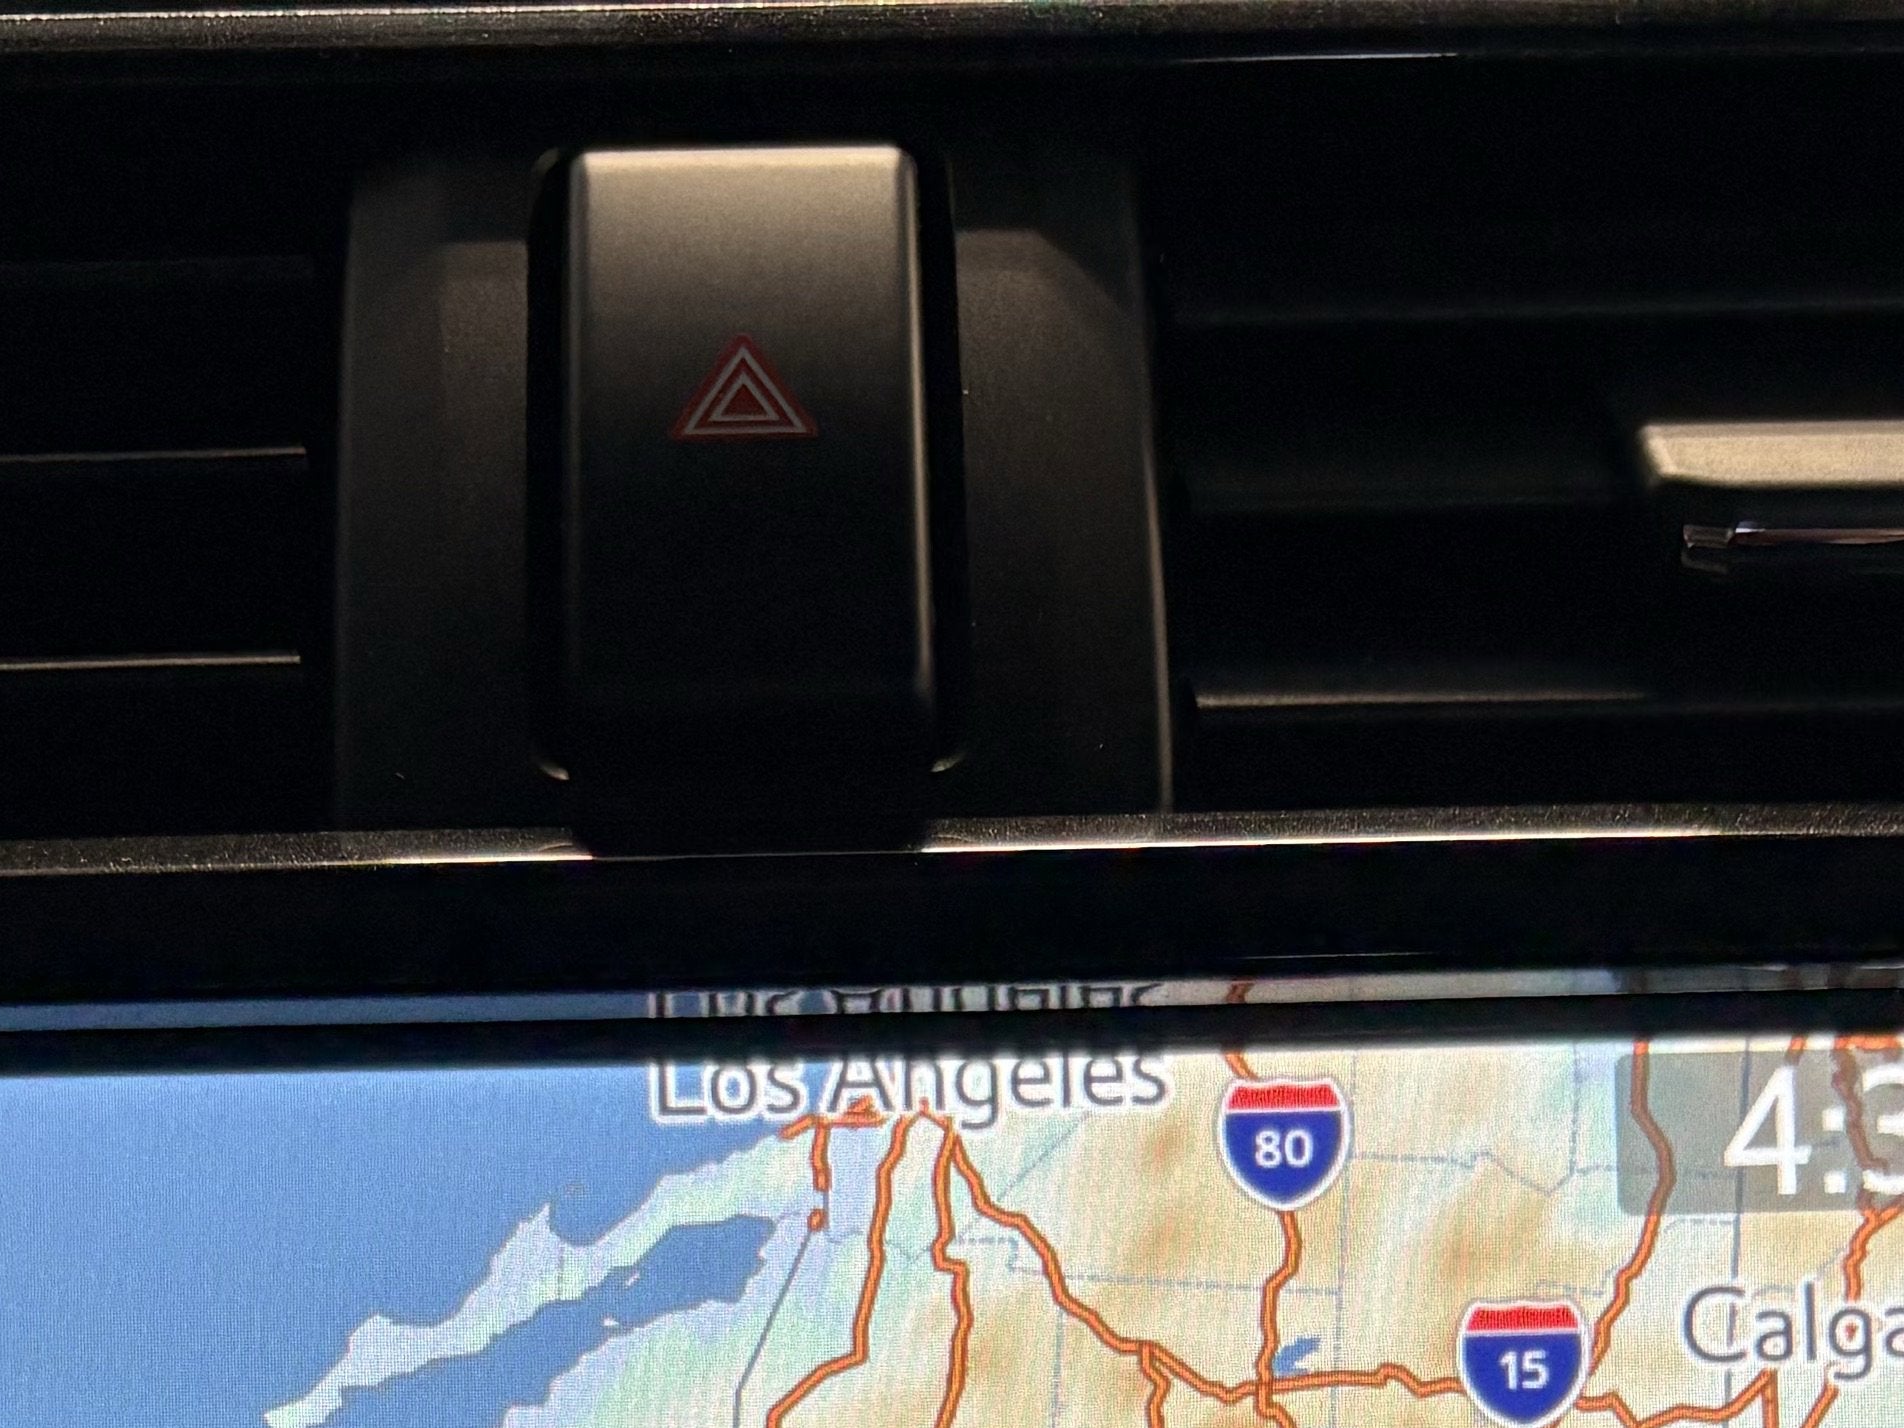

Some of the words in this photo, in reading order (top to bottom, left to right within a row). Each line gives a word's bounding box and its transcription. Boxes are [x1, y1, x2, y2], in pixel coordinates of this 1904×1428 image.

[658, 1053, 804, 1118] Los
[834, 1048, 1168, 1131] Angeles
[1256, 1126, 1314, 1173] 80
[1499, 1347, 1549, 1392] 15
